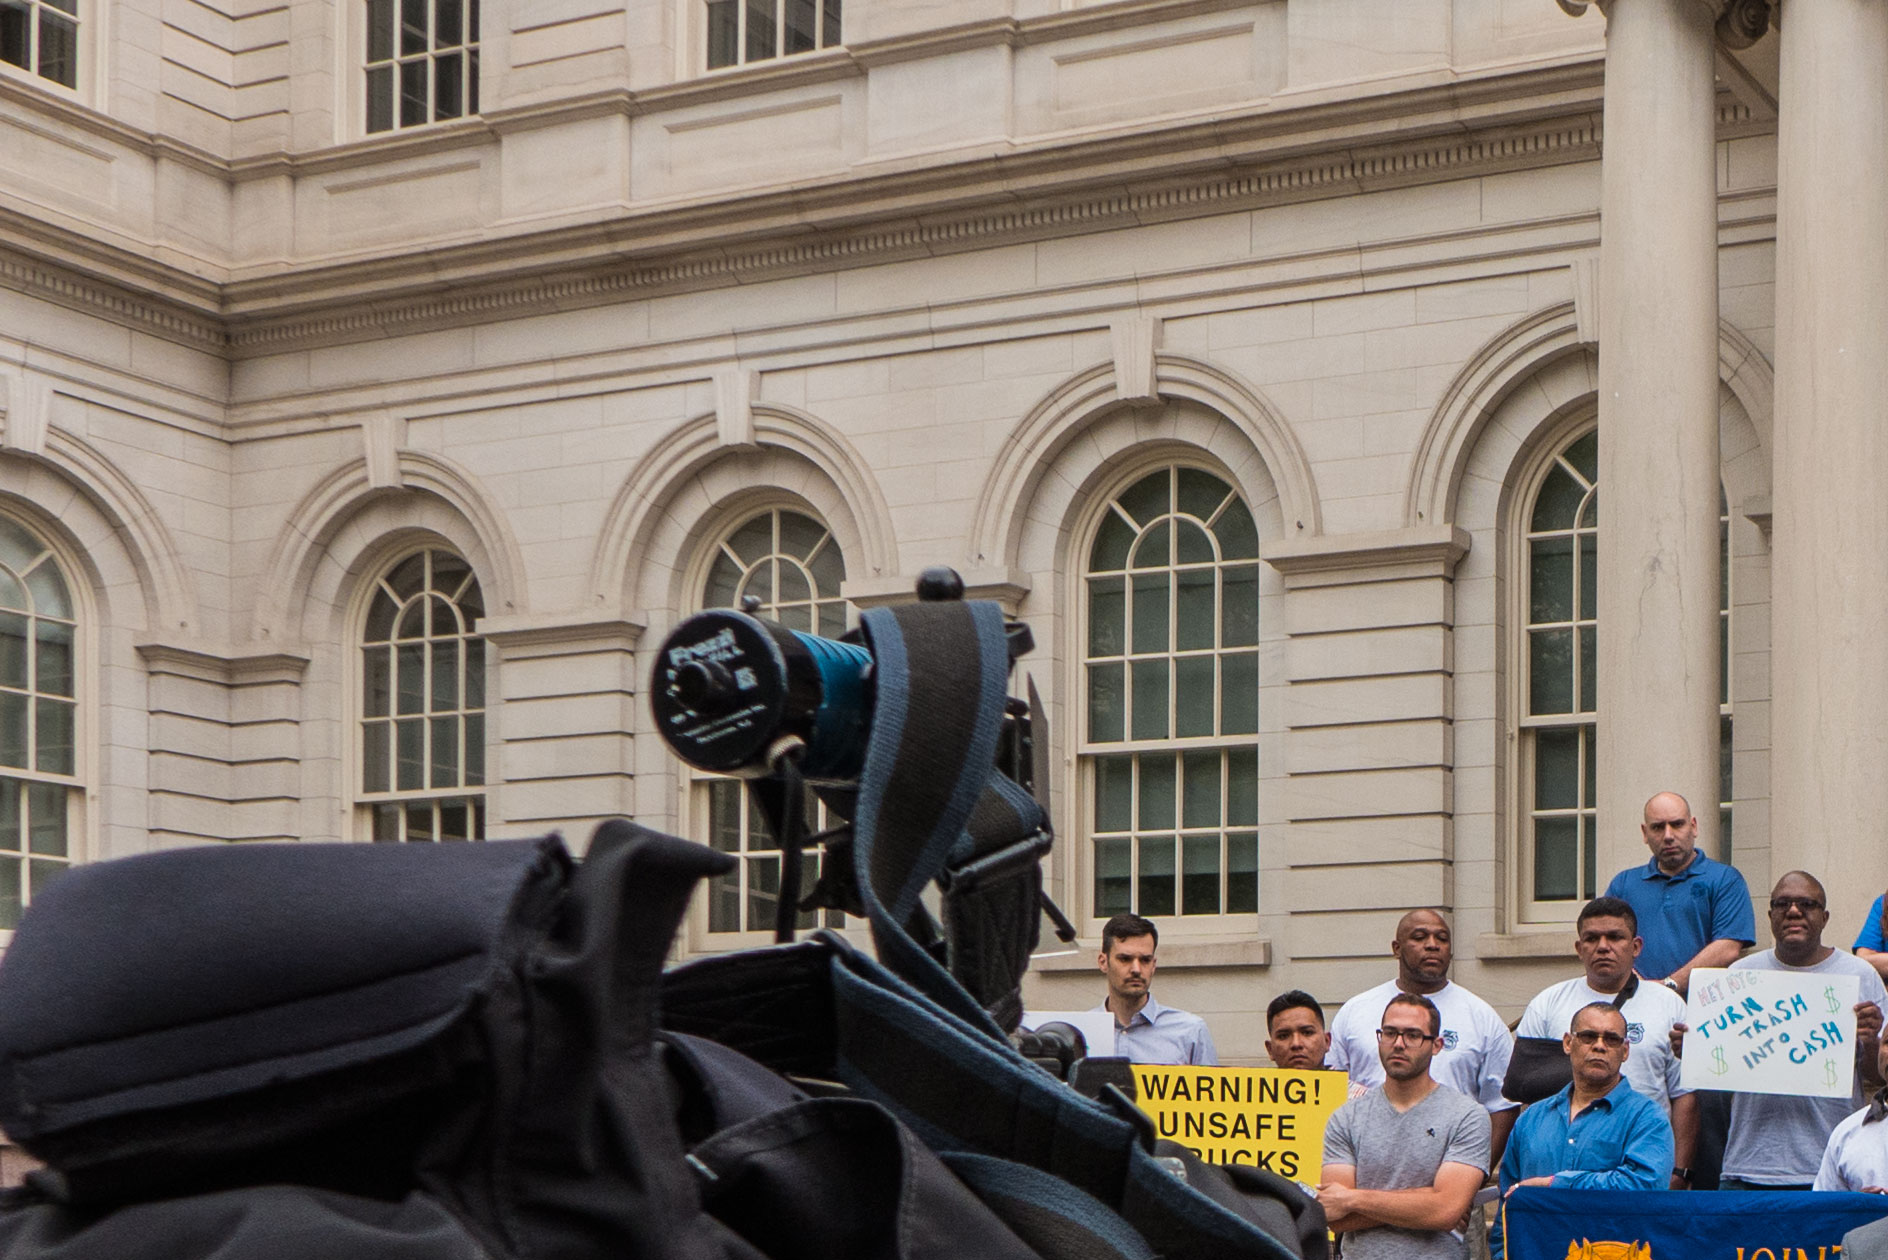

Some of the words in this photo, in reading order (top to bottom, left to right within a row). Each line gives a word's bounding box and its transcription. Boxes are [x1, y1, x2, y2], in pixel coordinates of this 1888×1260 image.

[1697, 996, 1763, 1039] TURN
[1738, 993, 1808, 1039] TRASH
[1742, 1032, 1791, 1070] INTO
[1789, 1021, 1843, 1064] CASH
[1142, 1074, 1320, 1105] WARNING!
[1159, 1111, 1296, 1140] UNSAFE
